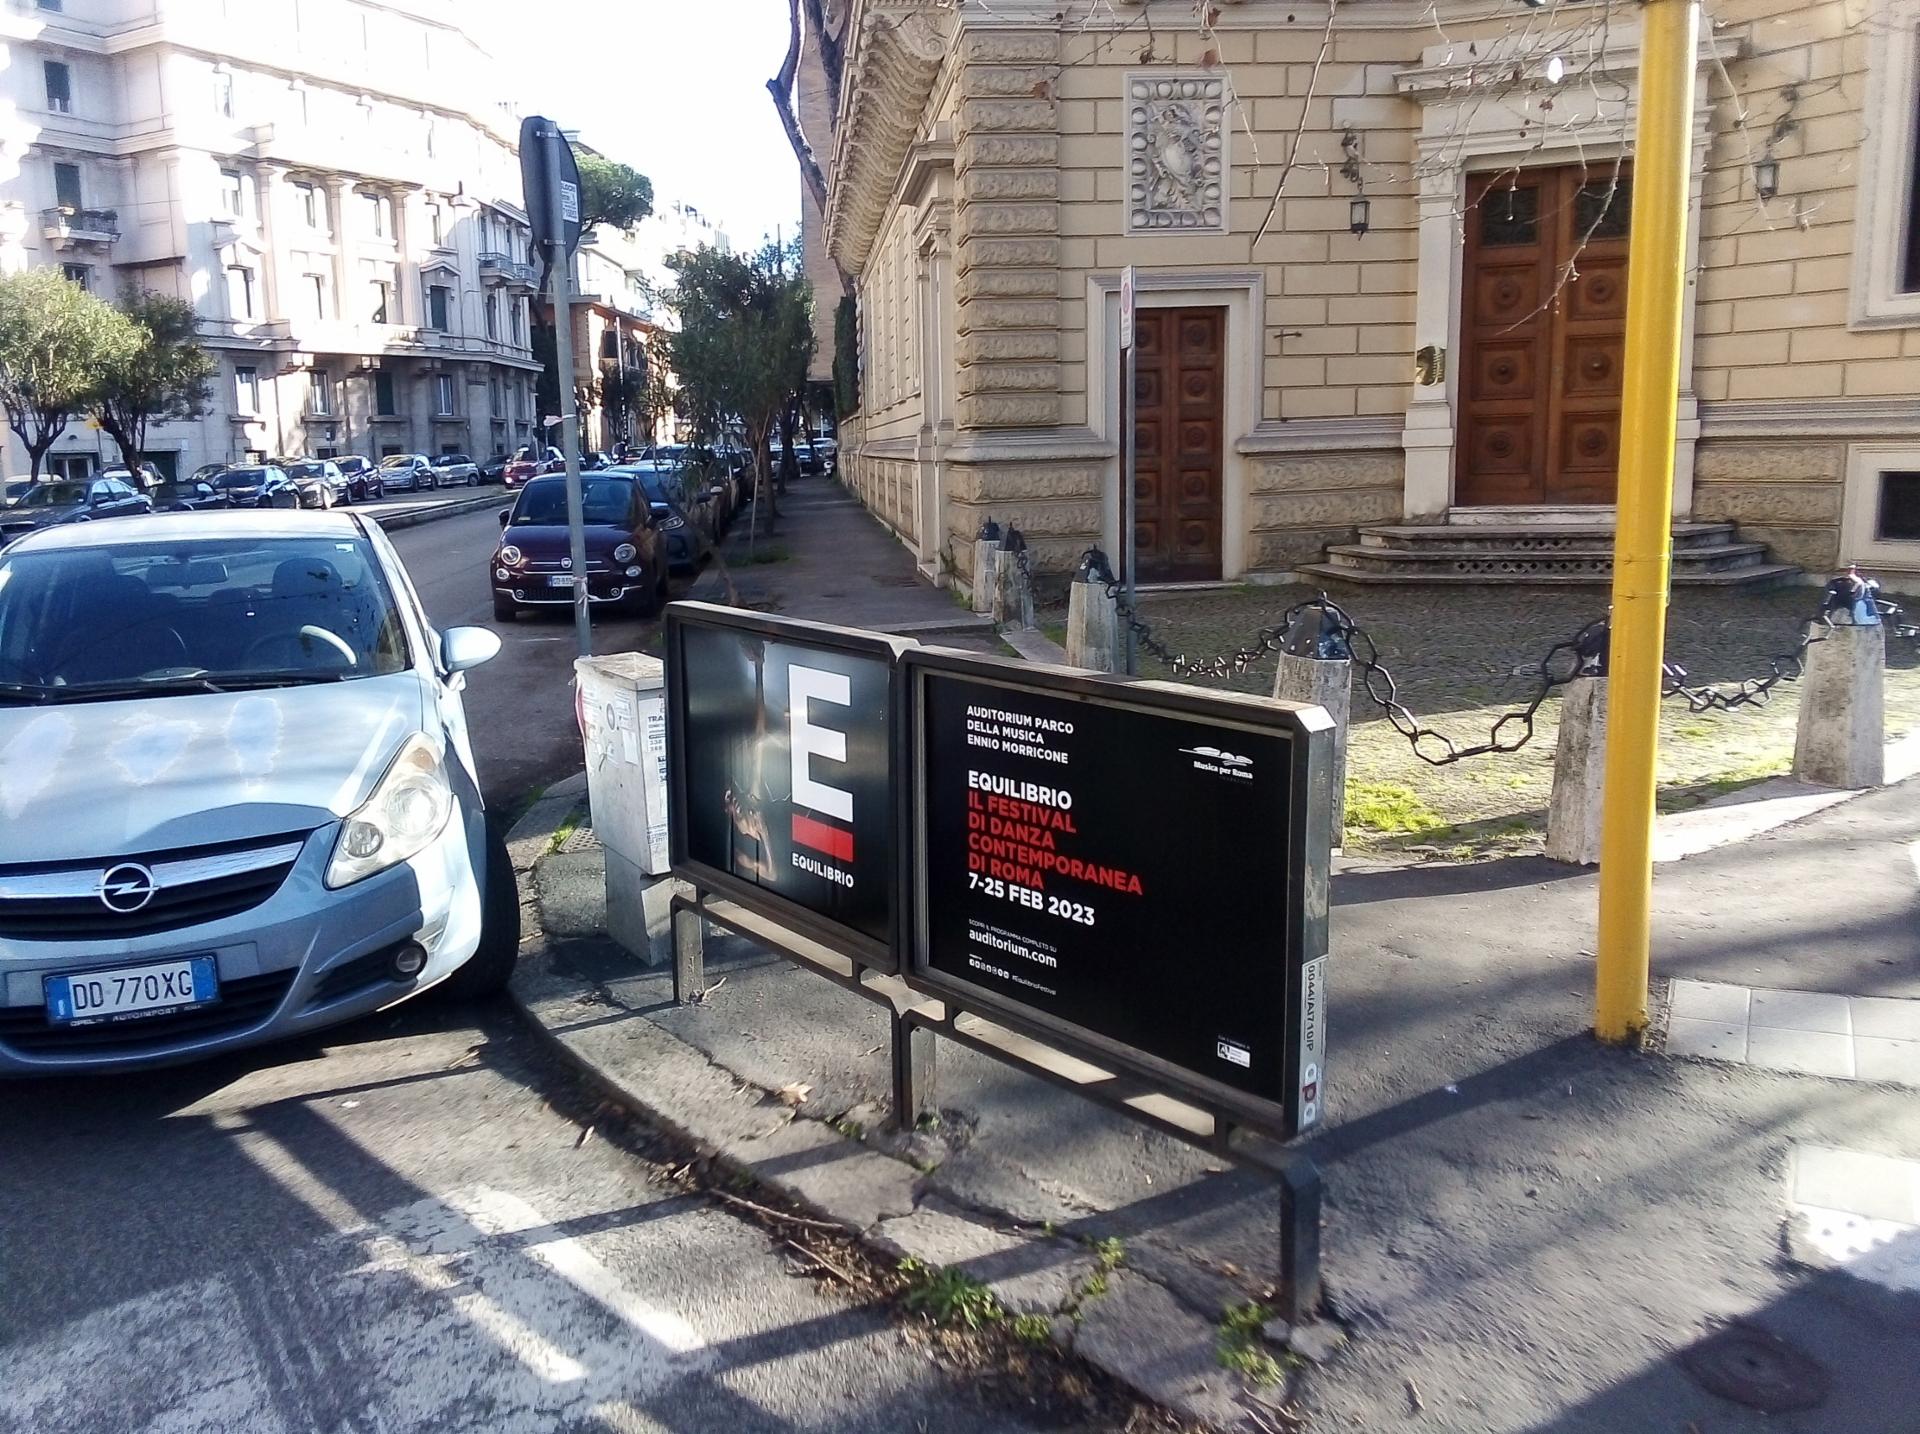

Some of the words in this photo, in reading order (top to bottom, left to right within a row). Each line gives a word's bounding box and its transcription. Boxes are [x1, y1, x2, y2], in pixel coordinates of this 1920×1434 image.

[966, 705, 1033, 727] AUDITORIUM
[1034, 717, 1074, 734] PARCO
[967, 719, 1000, 736] DELLA
[1002, 726, 1044, 744] MUSICA
[789, 663, 853, 823] E
[967, 734, 999, 750] ENNIO
[1002, 742, 1069, 764] MORRICONE
[1193, 760, 1218, 772] Musica
[1219, 767, 1231, 775] per
[1232, 768, 1253, 779] Roma
[968, 770, 1072, 810] EQUILIBRIO
[968, 791, 983, 811] IL
[988, 795, 1077, 834] FESTIVAL
[968, 811, 985, 831] DI
[990, 817, 1055, 850] DANZA
[792, 852, 854, 888] EQUILIBRIO
[968, 832, 1143, 896] CONTEMPORANEA
[968, 853, 985, 872] DI
[990, 858, 1044, 890] ROMA
[968, 871, 1004, 898] 7-25
[1008, 883, 1043, 910] FEB
[1048, 896, 1095, 926] 2023
[969, 929, 1057, 968] auditorium.com
[72, 981, 104, 1011] DD
[112, 970, 193, 1006] 770XG
[112, 1007, 178, 1022] AUTOIMPORT
